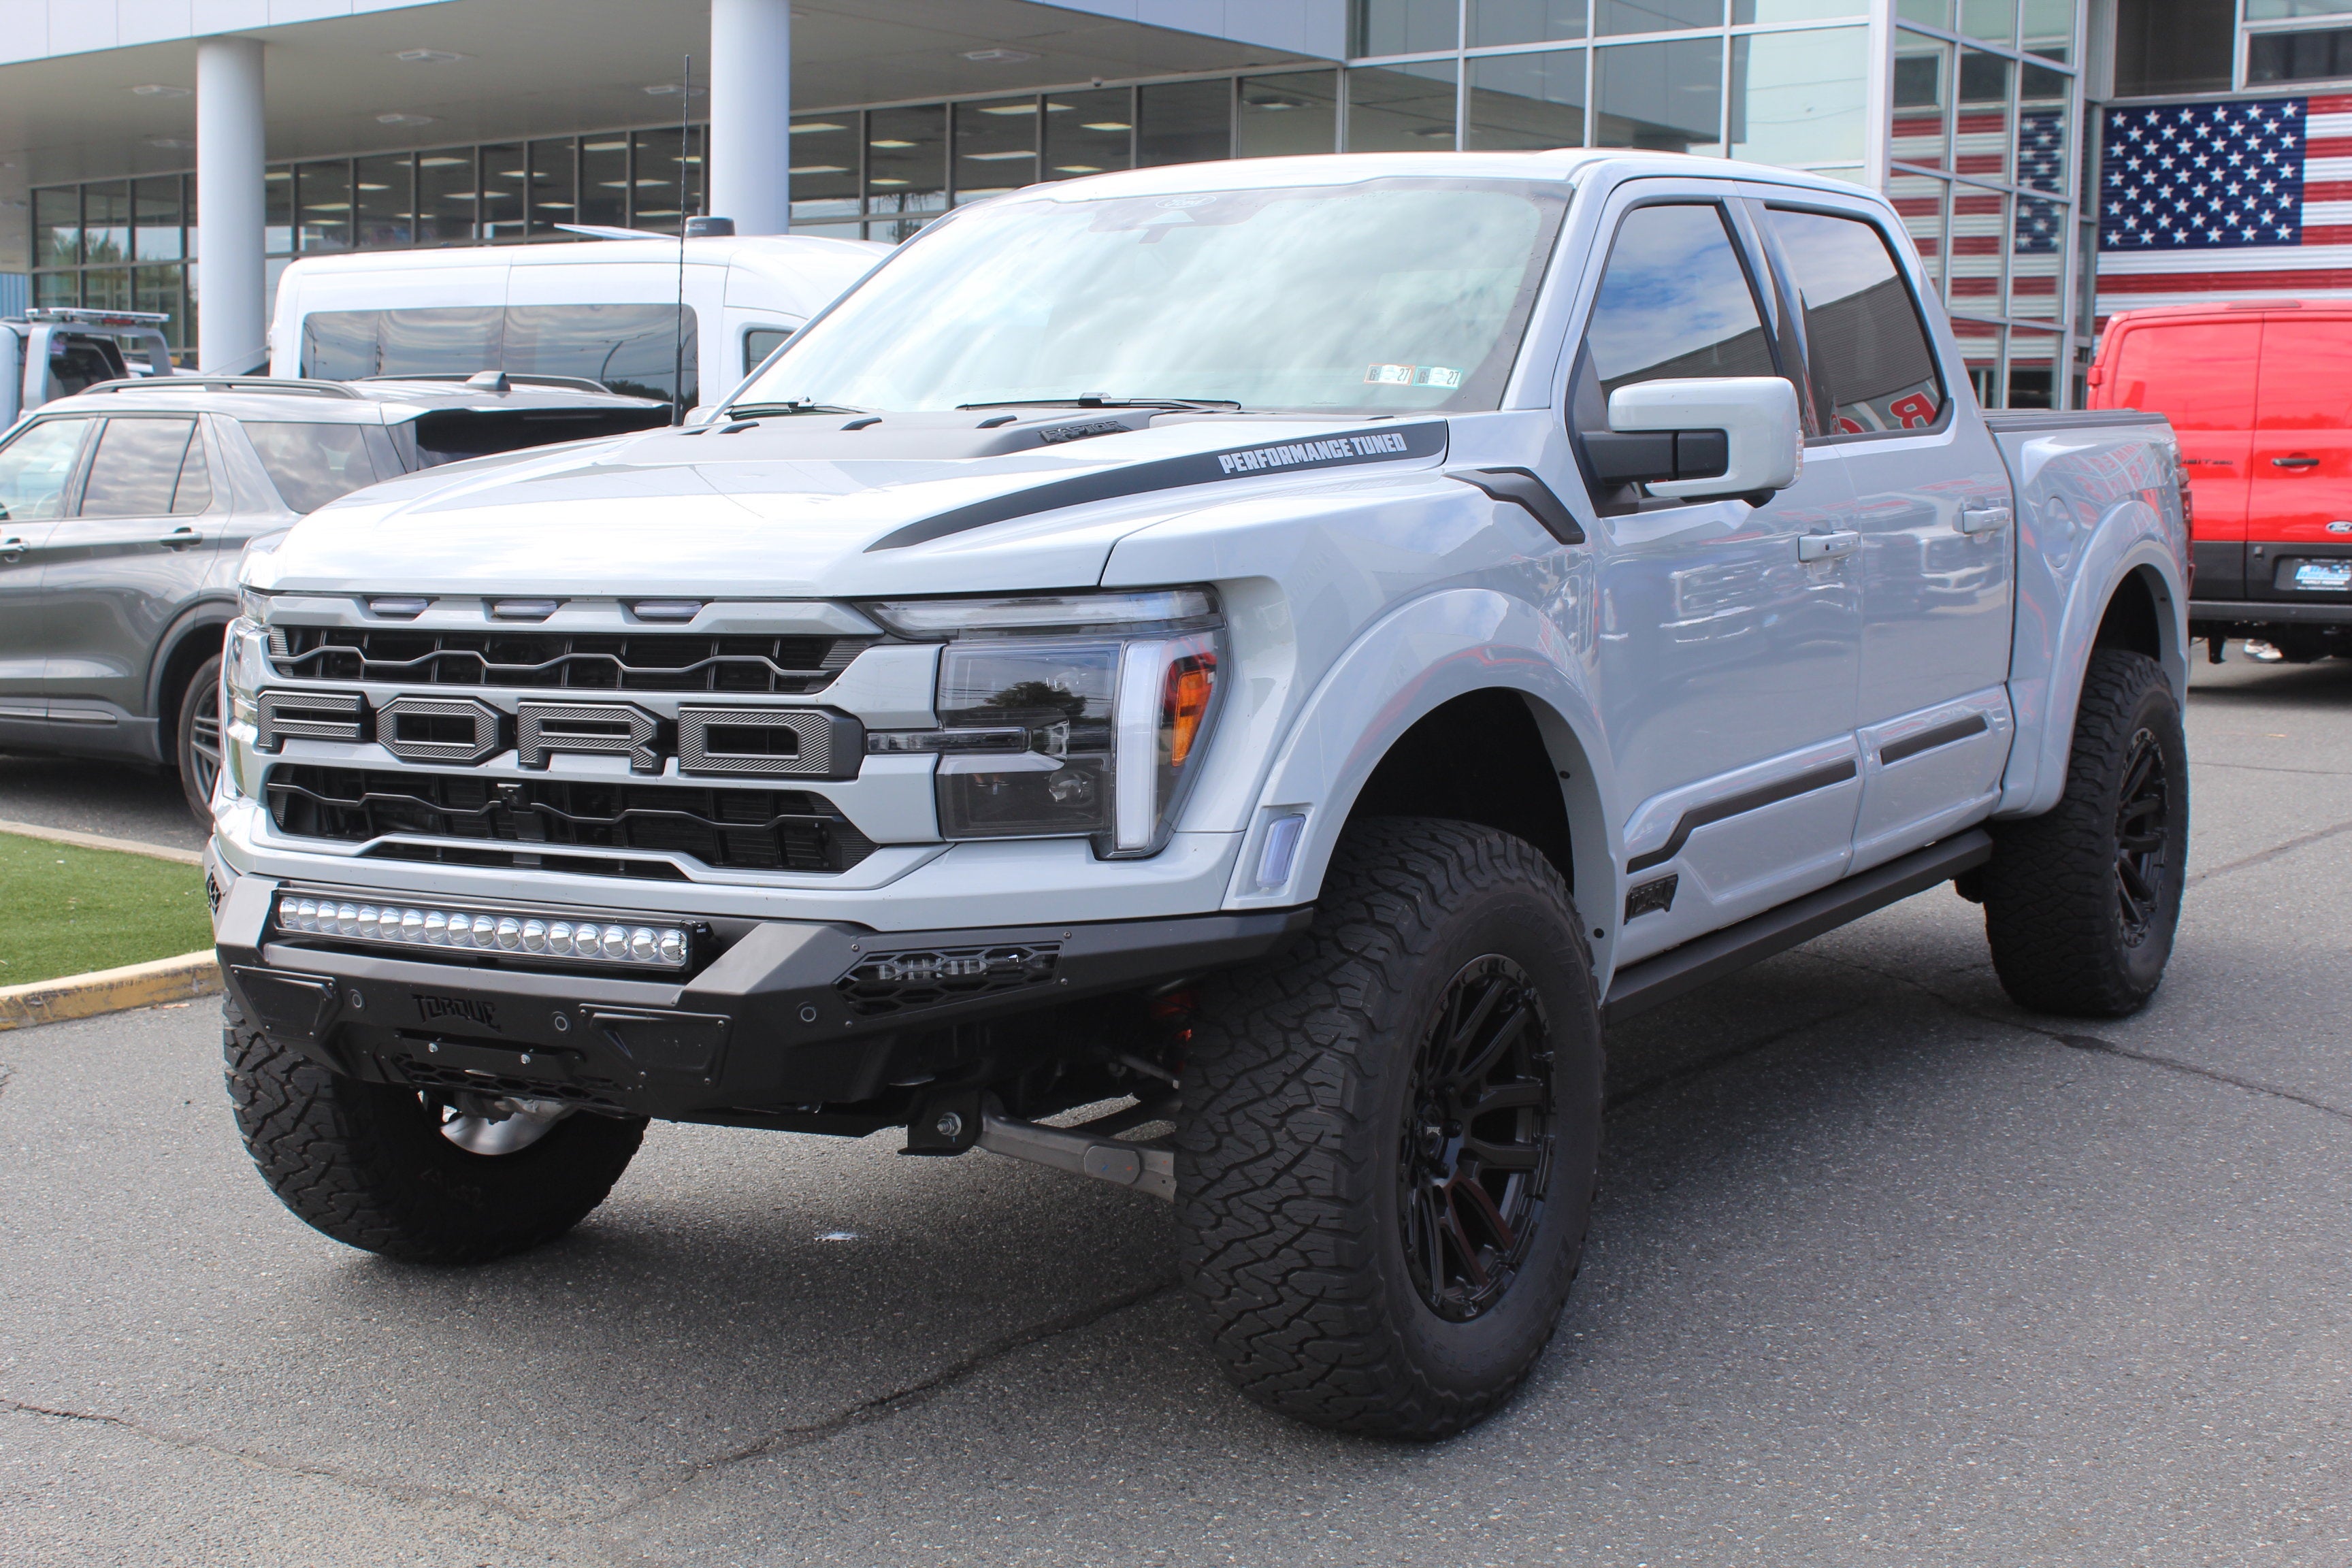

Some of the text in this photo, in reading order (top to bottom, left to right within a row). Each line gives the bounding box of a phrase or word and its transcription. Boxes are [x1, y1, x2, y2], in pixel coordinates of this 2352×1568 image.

[1397, 368, 1410, 382] 27
[1447, 372, 1460, 385] 27
[1039, 421, 1130, 443] RAPTOR
[1218, 433, 1408, 474] PERFORMANCE TUNED
[256, 689, 855, 778] FORD
[411, 994, 504, 1034] TORQUE
